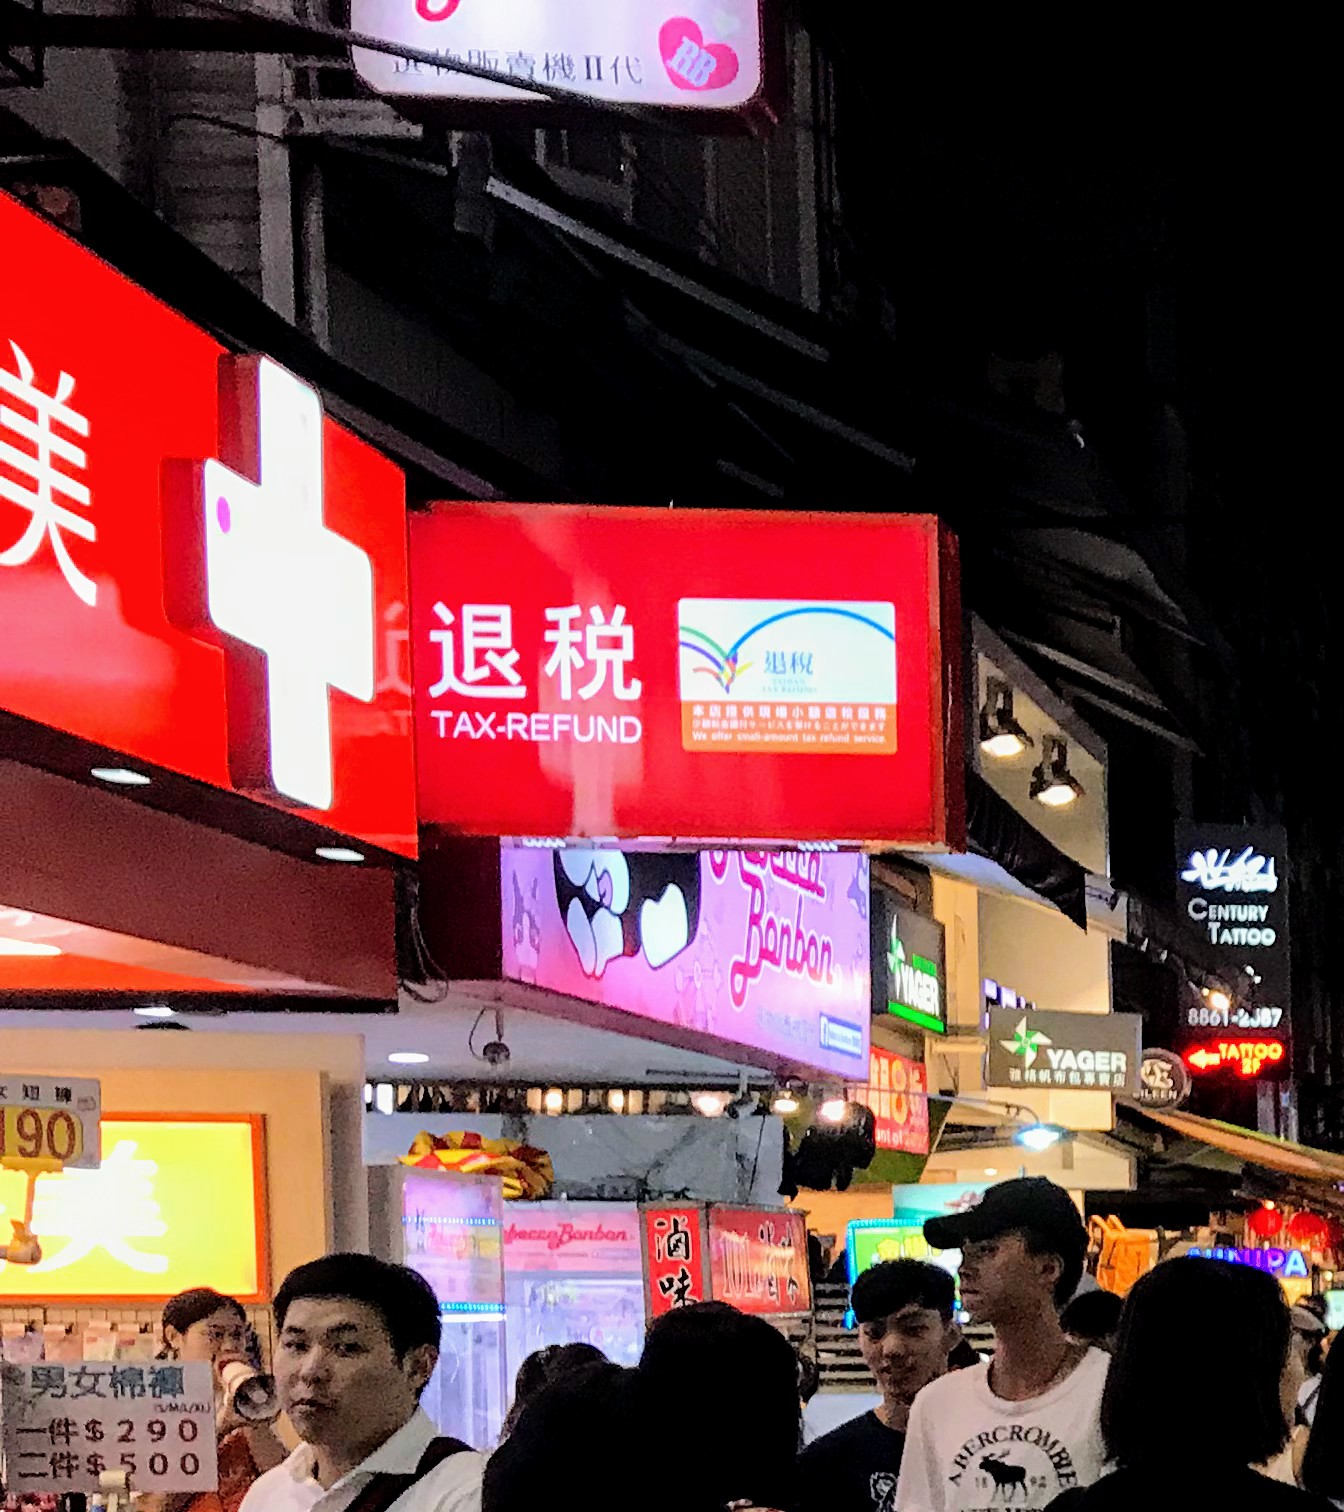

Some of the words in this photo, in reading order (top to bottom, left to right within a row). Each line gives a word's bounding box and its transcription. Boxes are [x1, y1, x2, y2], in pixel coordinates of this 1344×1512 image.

[430, 710, 643, 744] TAX-REFUND
[901, 965, 941, 1017] YAGER
[1046, 1049, 1127, 1073] YAGER
[1219, 1043, 1283, 1060] TATTOO
